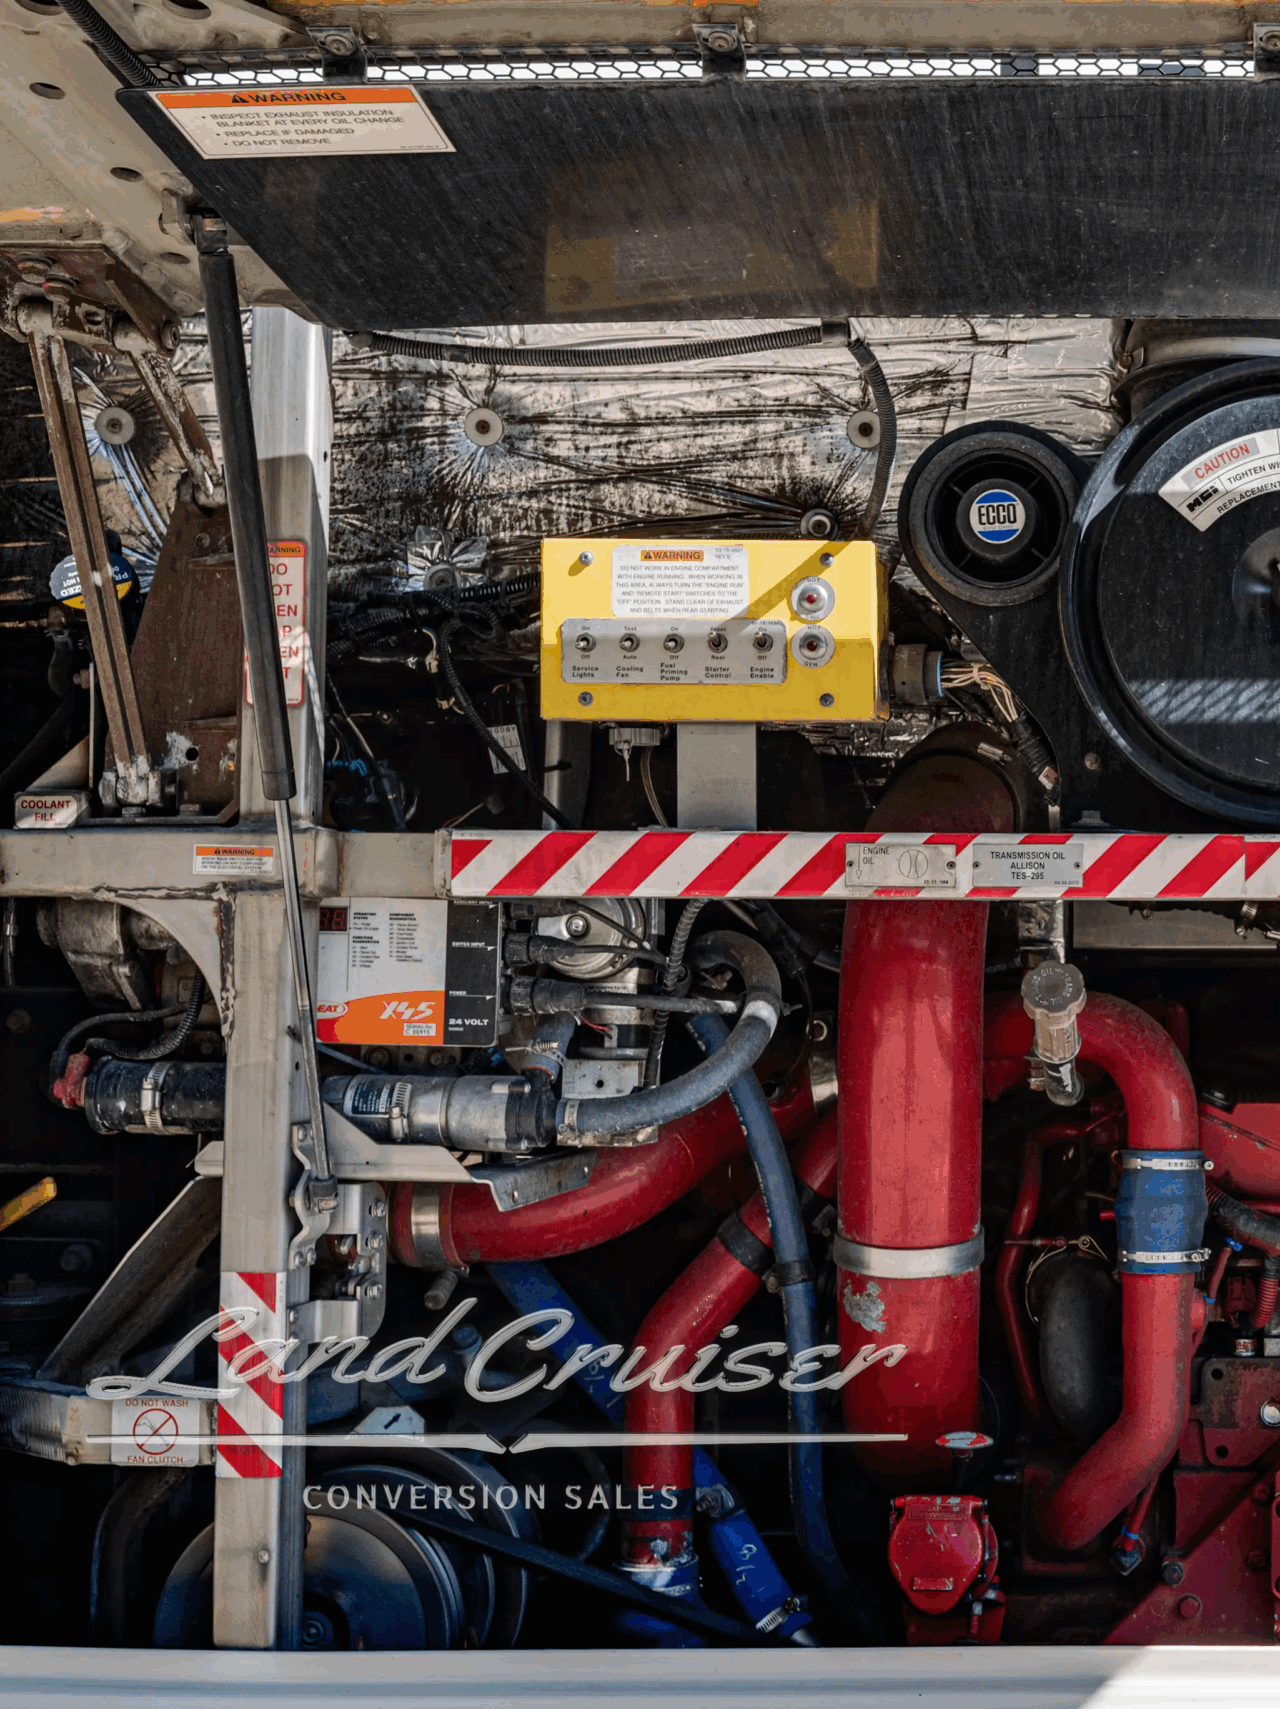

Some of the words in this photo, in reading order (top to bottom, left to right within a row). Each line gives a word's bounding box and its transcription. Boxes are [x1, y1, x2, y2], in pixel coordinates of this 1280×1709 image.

[248, 92, 346, 103] WARNING
[209, 112, 261, 120] INSPECT
[264, 111, 319, 119] EXHAUST
[322, 109, 392, 117] INSULATION
[290, 118, 328, 126] EVERY
[353, 116, 406, 124] CHANGE
[224, 129, 279, 137] REPLACE
[280, 138, 332, 146] REMOVE
[1194, 443, 1250, 479] CAUTION
[1227, 465, 1266, 485] TIGHTEN
[977, 503, 1017, 525] ECCO
[653, 551, 701, 560] WARNING
[272, 584, 293, 596] OT
[276, 604, 298, 617] EN
[21, 799, 71, 809] COOLANT
[34, 812, 55, 821] FILL
[222, 848, 255, 856] WARNING
[862, 847, 890, 855] ENGINE
[990, 852, 1050, 860] TRANSMISSION
[1052, 852, 1066, 860] OIL
[862, 857, 875, 865] OIL
[1010, 861, 1045, 870] ALLISON
[1011, 871, 1044, 880] TES-295
[317, 1004, 339, 1013] EAT
[379, 1000, 436, 1020] X45
[464, 1018, 489, 1026] VOLT
[125, 1399, 139, 1407] DO
[141, 1399, 159, 1407] NOT
[161, 1399, 188, 1407] WASH
[147, 1456, 184, 1464] CLUTCH
